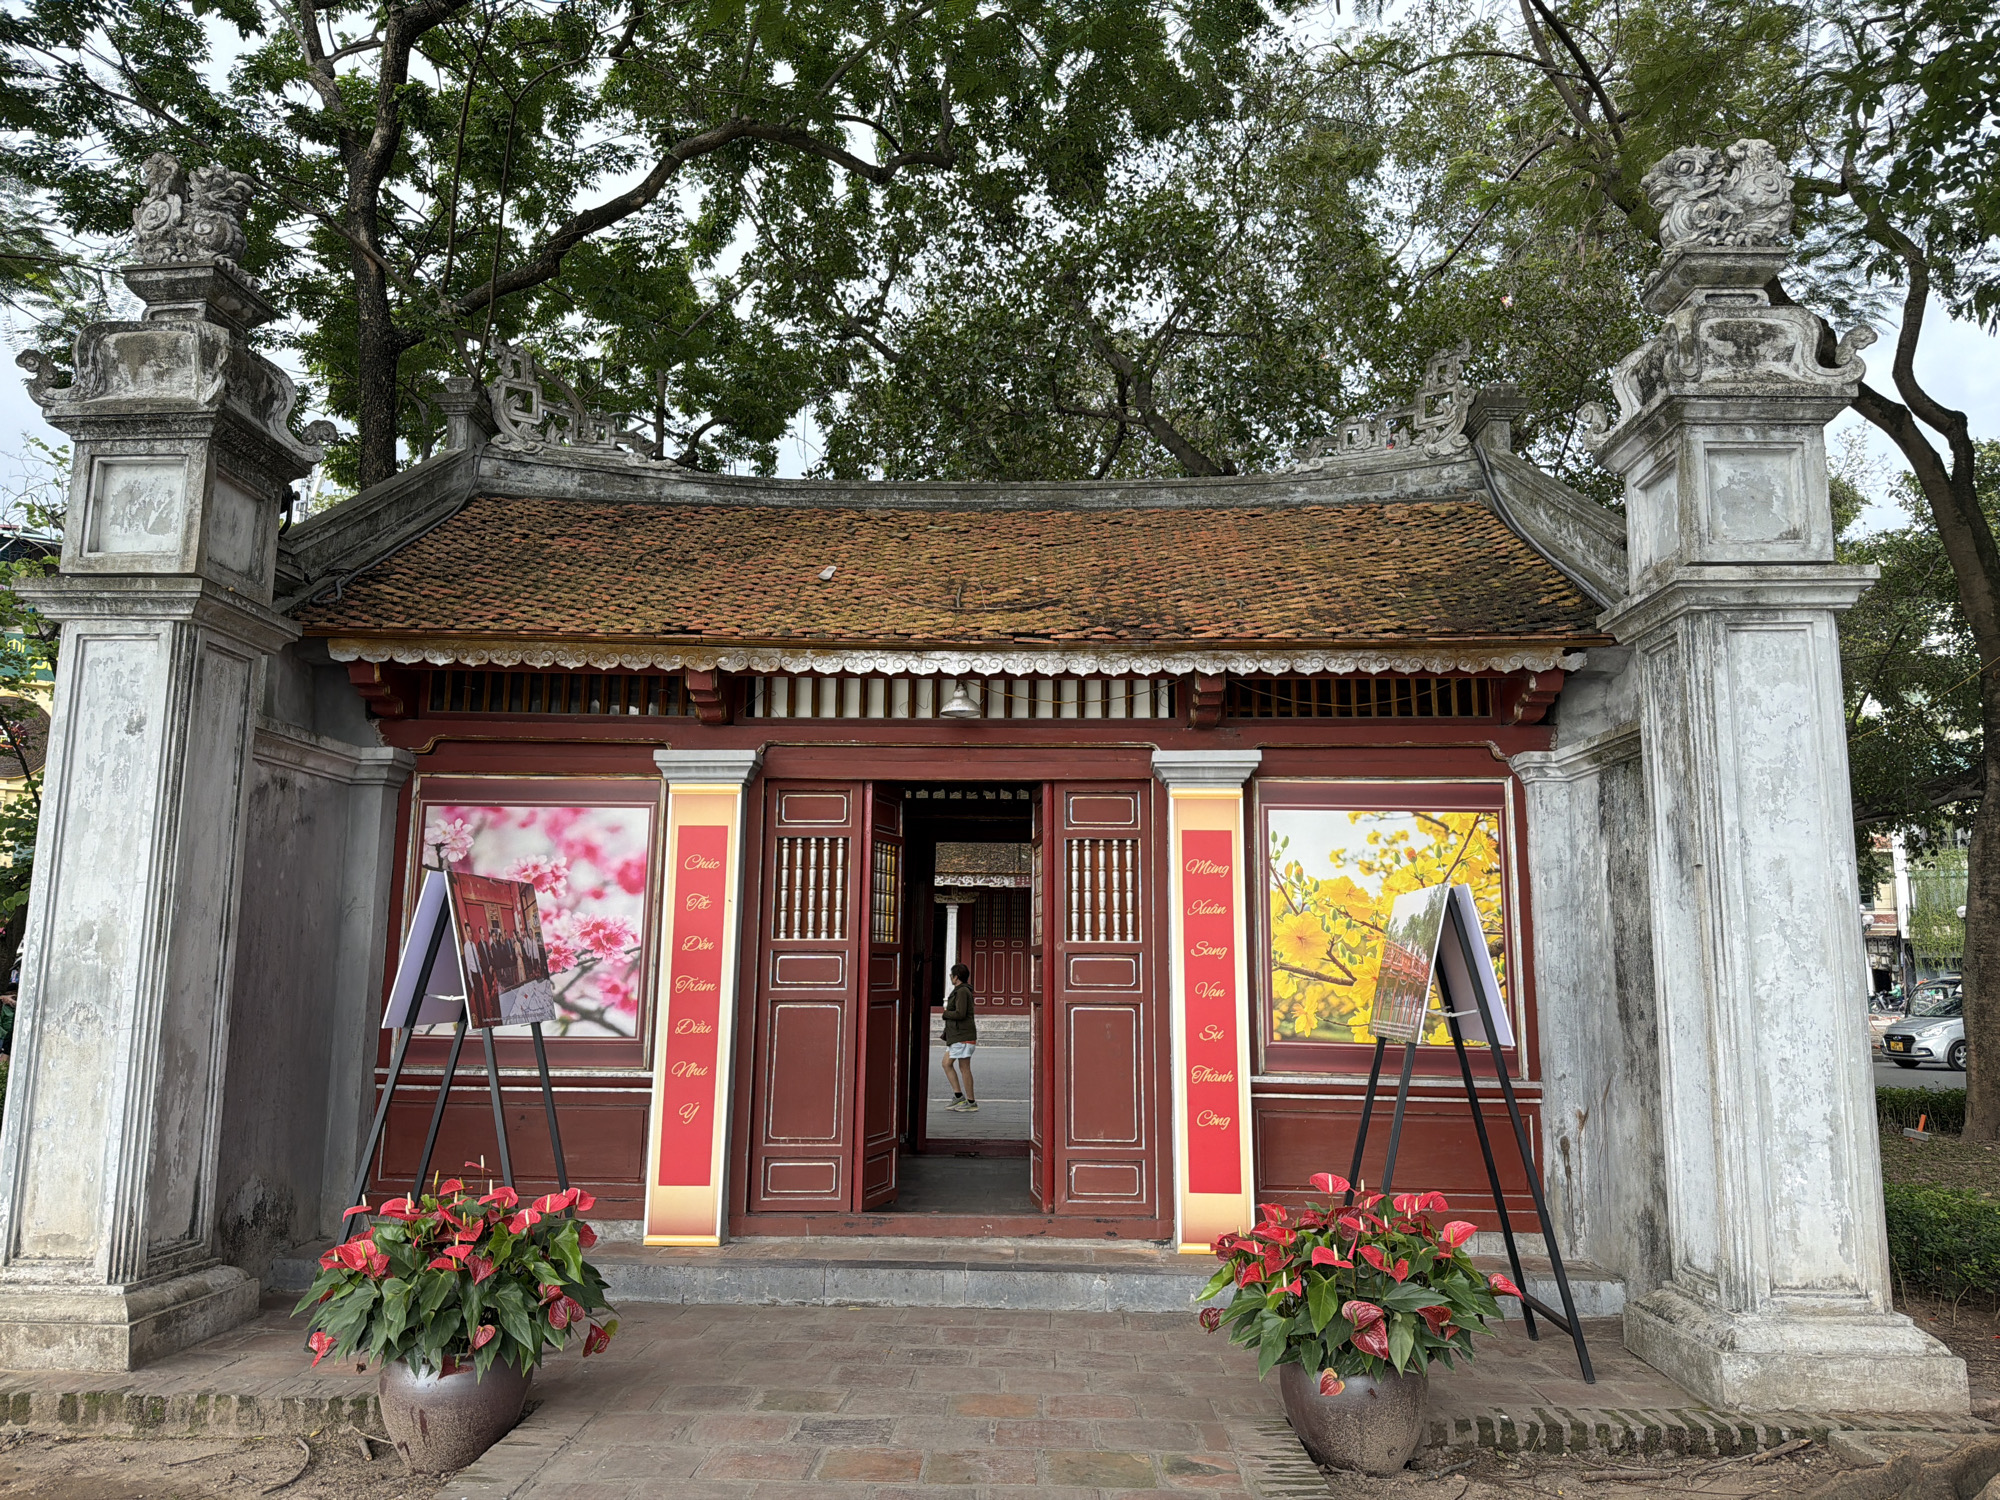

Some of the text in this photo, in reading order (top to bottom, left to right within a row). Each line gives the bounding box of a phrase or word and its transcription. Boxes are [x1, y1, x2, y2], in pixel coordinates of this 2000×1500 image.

[684, 854, 720, 870] Chúc
[686, 893, 712, 911] Tết
[1187, 899, 1227, 915] Xuân
[682, 935, 714, 951] Đến
[1190, 941, 1228, 959] Sang
[675, 975, 717, 994] Trăm
[1195, 981, 1226, 1000] Vạn
[675, 1018, 712, 1034] Điều
[1191, 1064, 1234, 1084] Thành
[678, 1101, 700, 1125] Ý
[1196, 1109, 1231, 1130] Công
